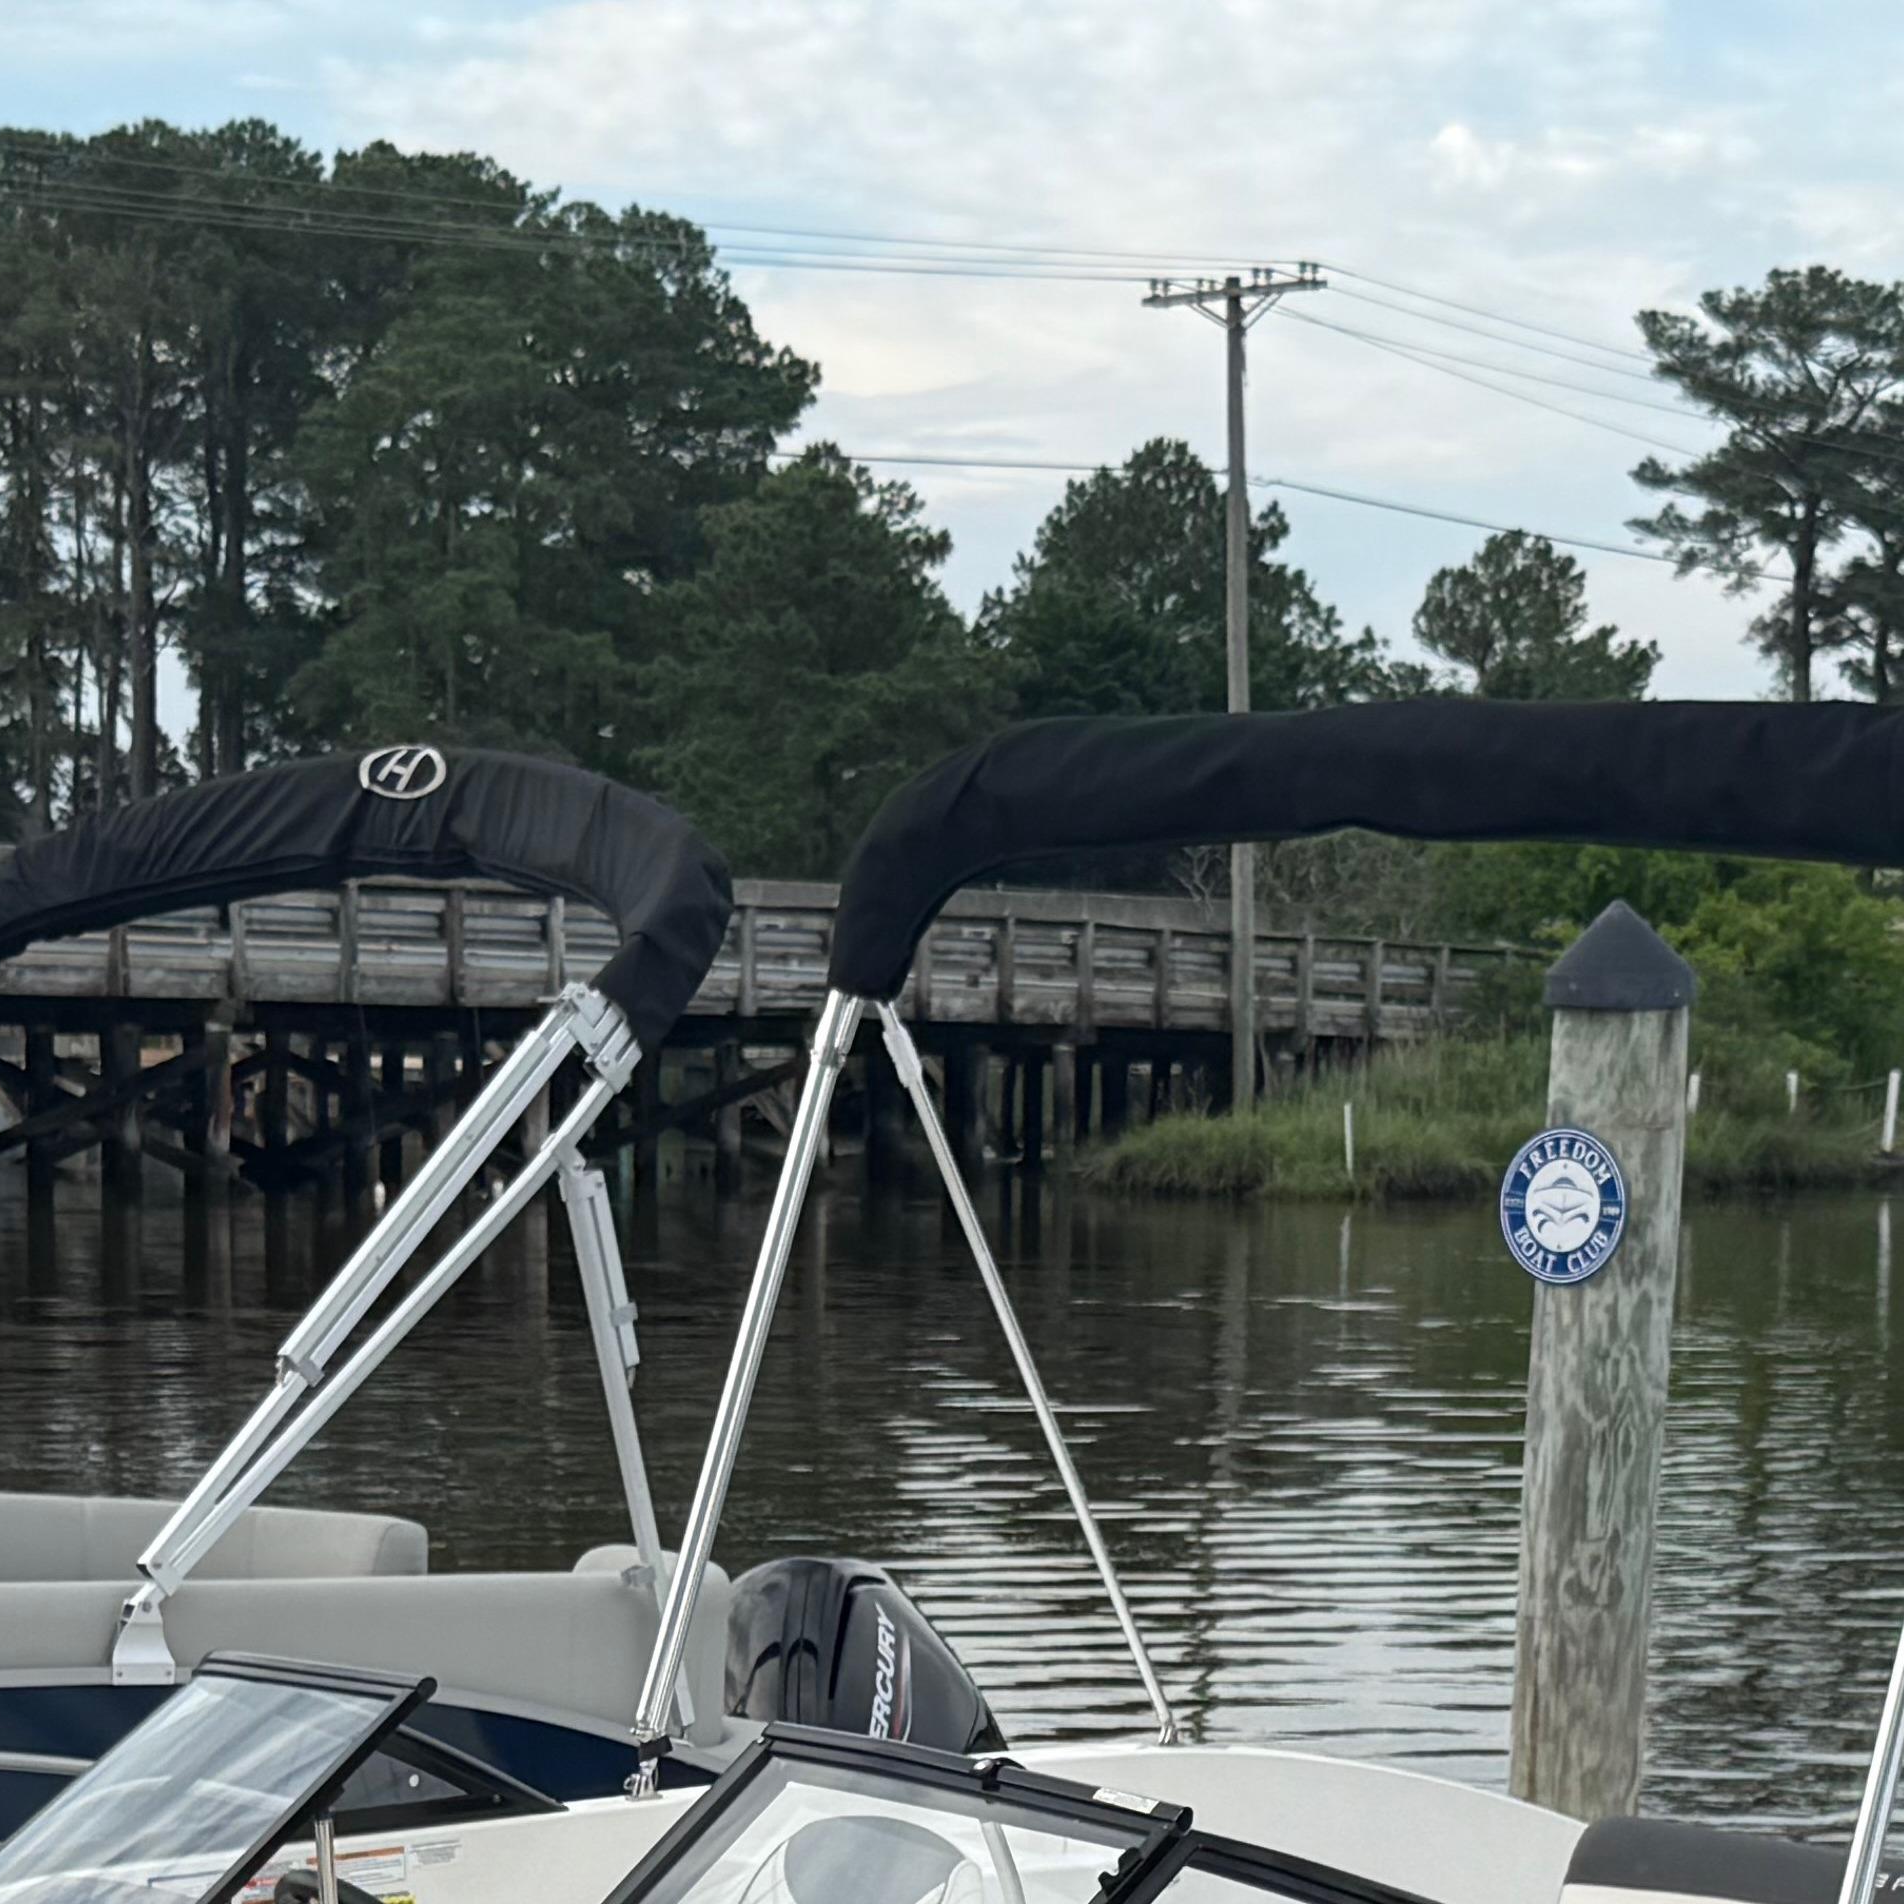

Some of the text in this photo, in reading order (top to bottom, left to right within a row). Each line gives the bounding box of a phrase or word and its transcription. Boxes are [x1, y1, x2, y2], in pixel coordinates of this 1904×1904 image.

[1519, 1138, 1611, 1186] FREEDOM
[1514, 1226, 1609, 1274] BOAT CLUB
[869, 1601, 896, 1740] ERCURY
